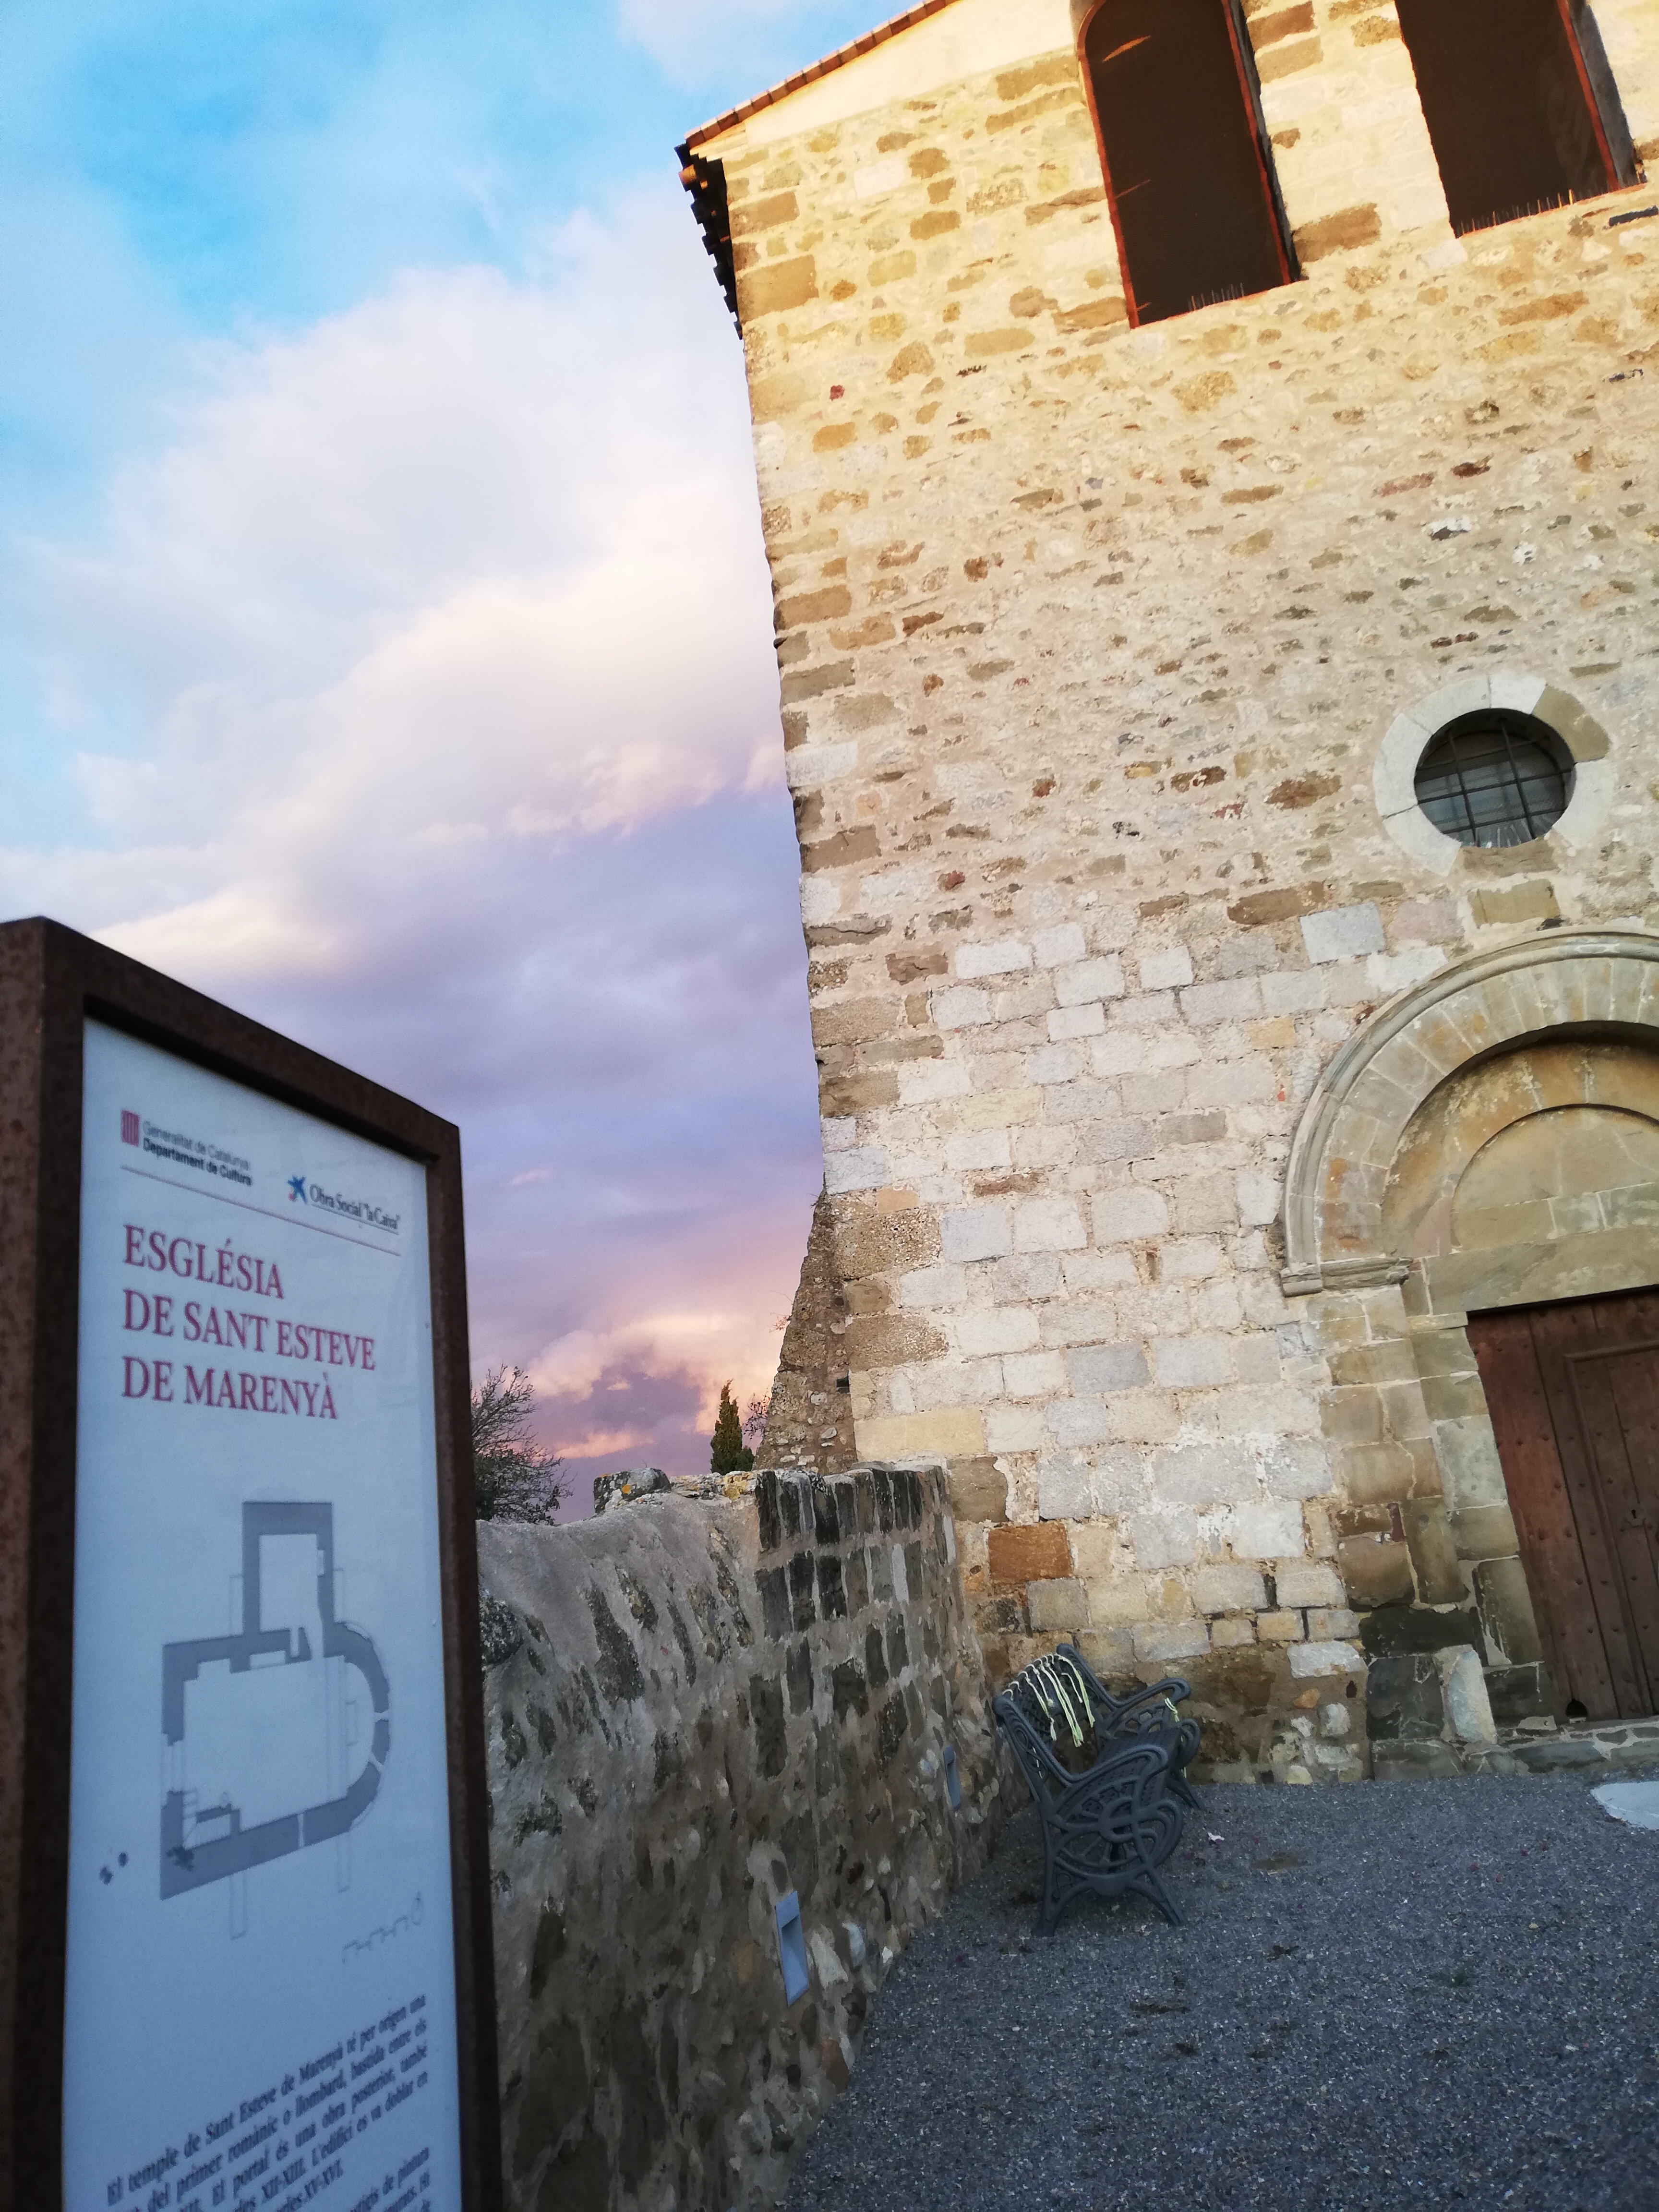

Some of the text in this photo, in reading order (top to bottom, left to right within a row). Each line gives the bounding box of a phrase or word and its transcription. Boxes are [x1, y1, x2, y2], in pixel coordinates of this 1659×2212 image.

[143, 1137, 252, 1187] Departament de Cultura
[309, 1183, 335, 1208] Obra
[123, 1223, 284, 1299] ESGLÉSIA
[123, 1288, 376, 1371] DE SANT ESTEVE
[122, 1355, 338, 1420] DE MARENYÀ
[107, 2175, 123, 2207] El
[128, 2146, 179, 2192] temple
[184, 2133, 201, 2158] de
[205, 2112, 235, 2145] Sant
[240, 2088, 276, 2123] Esteve
[281, 2073, 295, 2096] de
[300, 2041, 343, 2085] Marenyà
[361, 2025, 376, 2052] per
[378, 2007, 407, 2034] origen
[176, 2153, 222, 2204] primer
[228, 2116, 278, 2163] romànic
[283, 2109, 291, 2125] o
[213, 2177, 226, 2207] El
[233, 2144, 270, 2200] portal
[295, 2122, 316, 2148] una
[322, 2101, 346, 2129] obra
